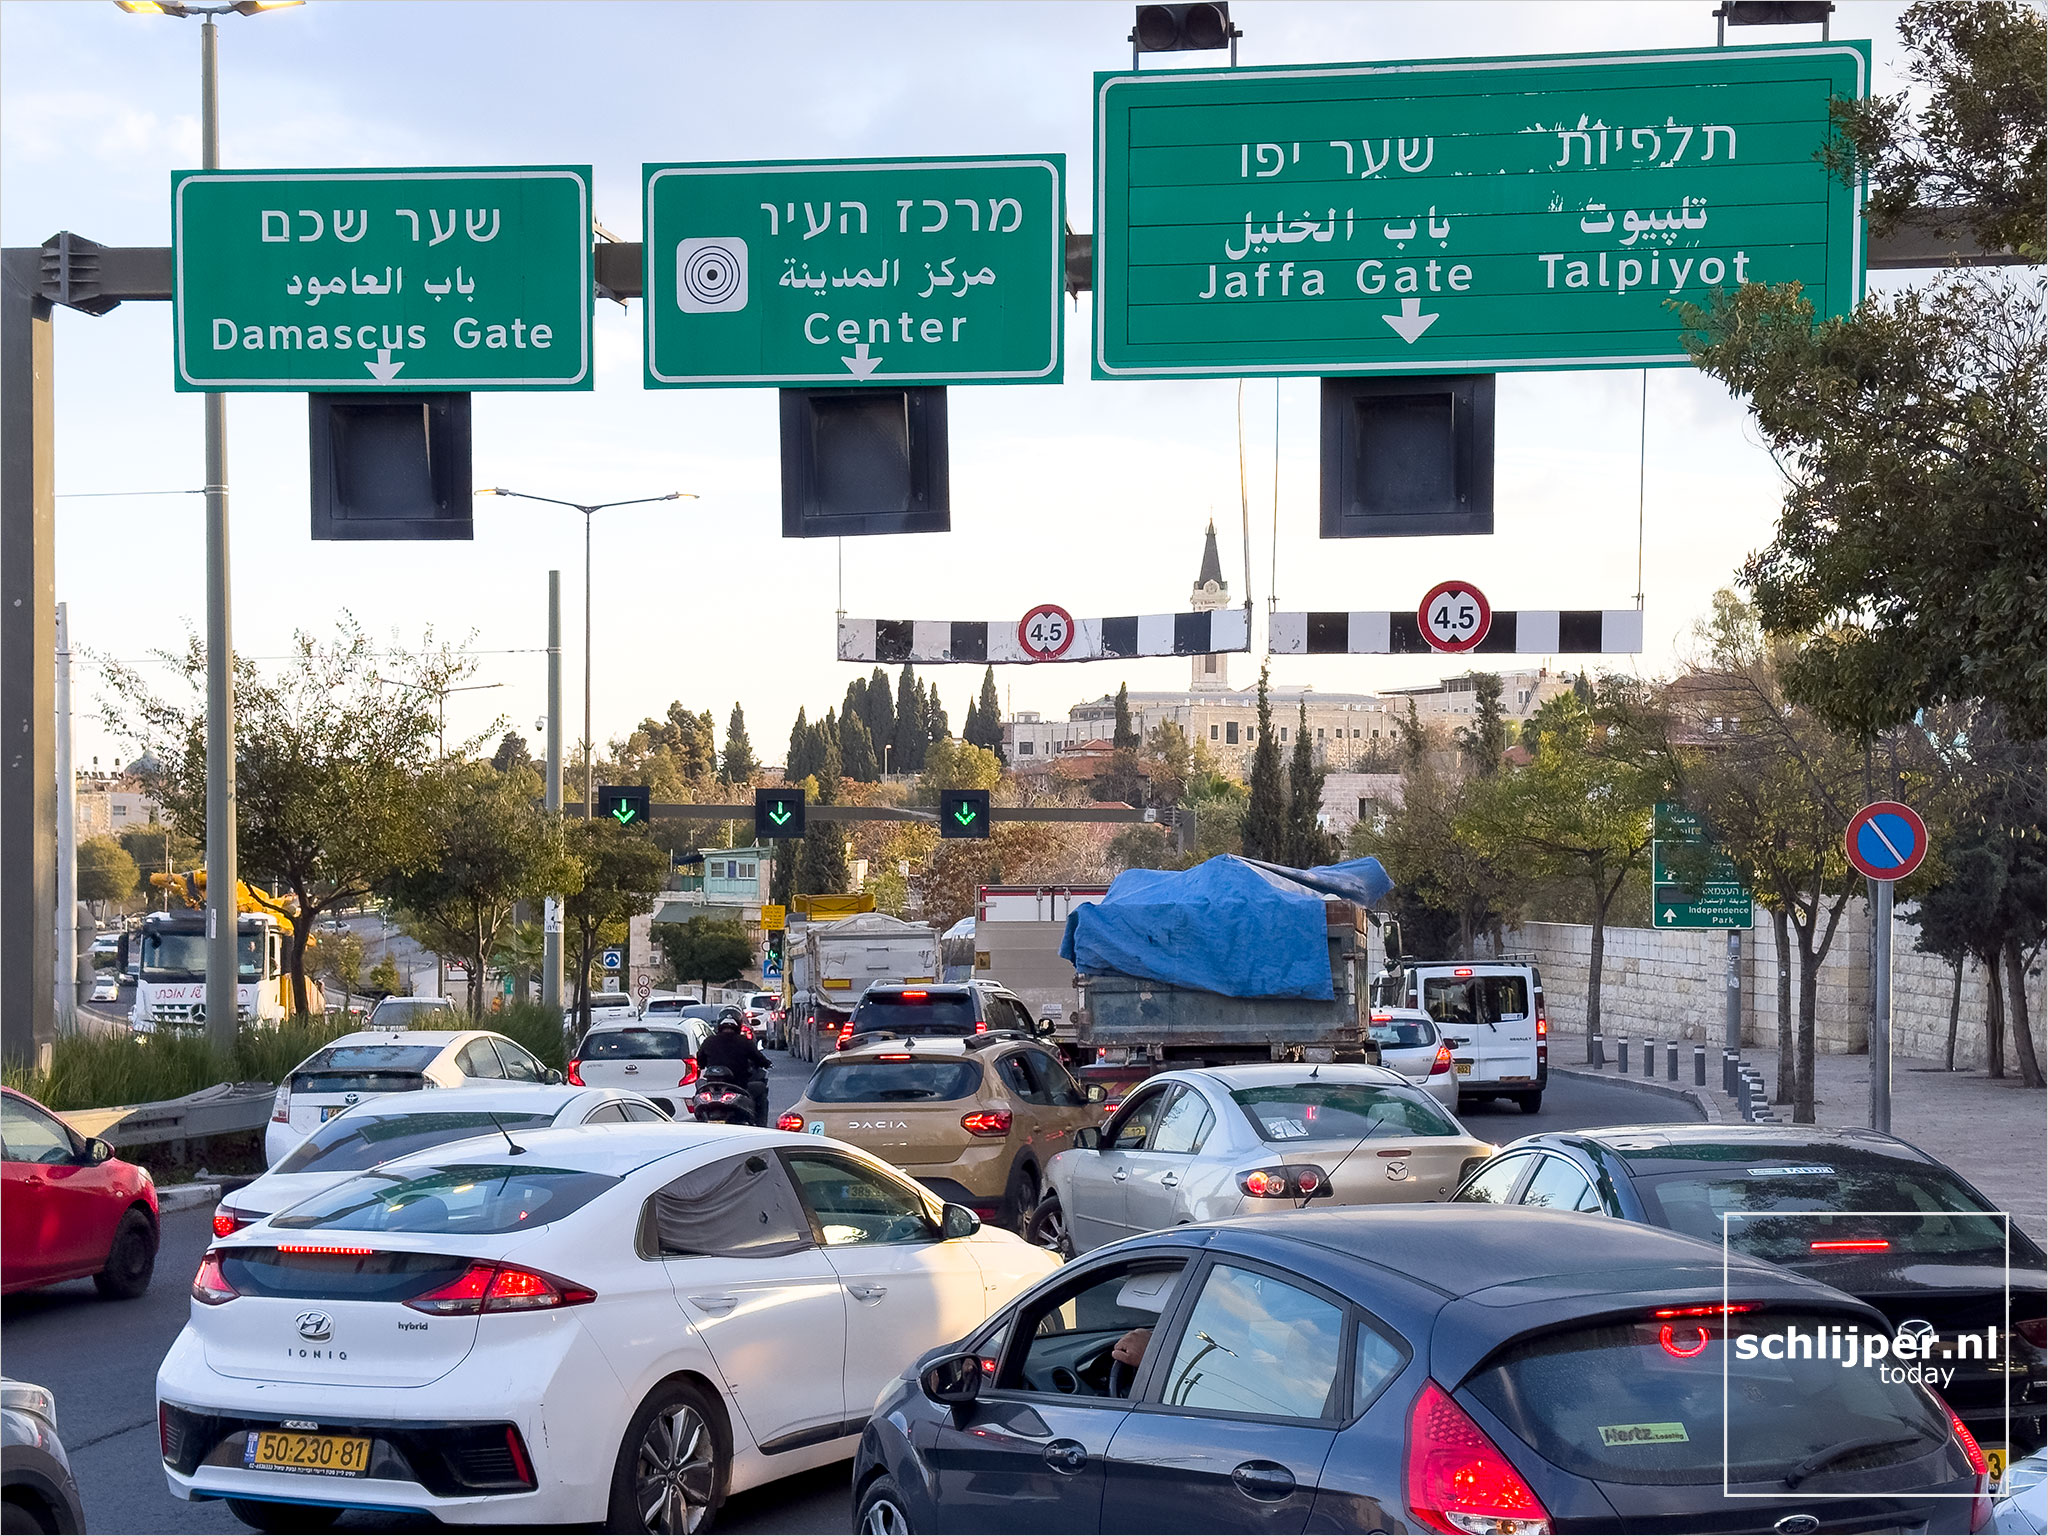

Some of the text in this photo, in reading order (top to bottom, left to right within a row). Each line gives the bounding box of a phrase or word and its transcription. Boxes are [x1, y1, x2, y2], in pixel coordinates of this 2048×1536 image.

[1242, 137, 1434, 178] שער יפו
[1557, 122, 1738, 167] תלפיות
[262, 209, 500, 246] שער שכם
[761, 198, 1023, 240] מרכז העיר
[1225, 205, 1452, 261] باب الخليل
[287, 266, 475, 306] باب العامود
[779, 256, 996, 298] مركز المدينة
[1199, 259, 1473, 299] Jaffa Gate
[1538, 250, 1750, 295] Talpiyot
[212, 318, 553, 351] Damascus Gate
[804, 312, 967, 345] Center
[1030, 623, 1062, 642] 4.5
[1434, 606, 1475, 629] 4.5
[1688, 906, 1749, 915] Independence
[1712, 916, 1734, 924] Park
[848, 1121, 908, 1129] DACIA
[398, 1321, 429, 1331] hybrid
[288, 1348, 348, 1360] IONIQ
